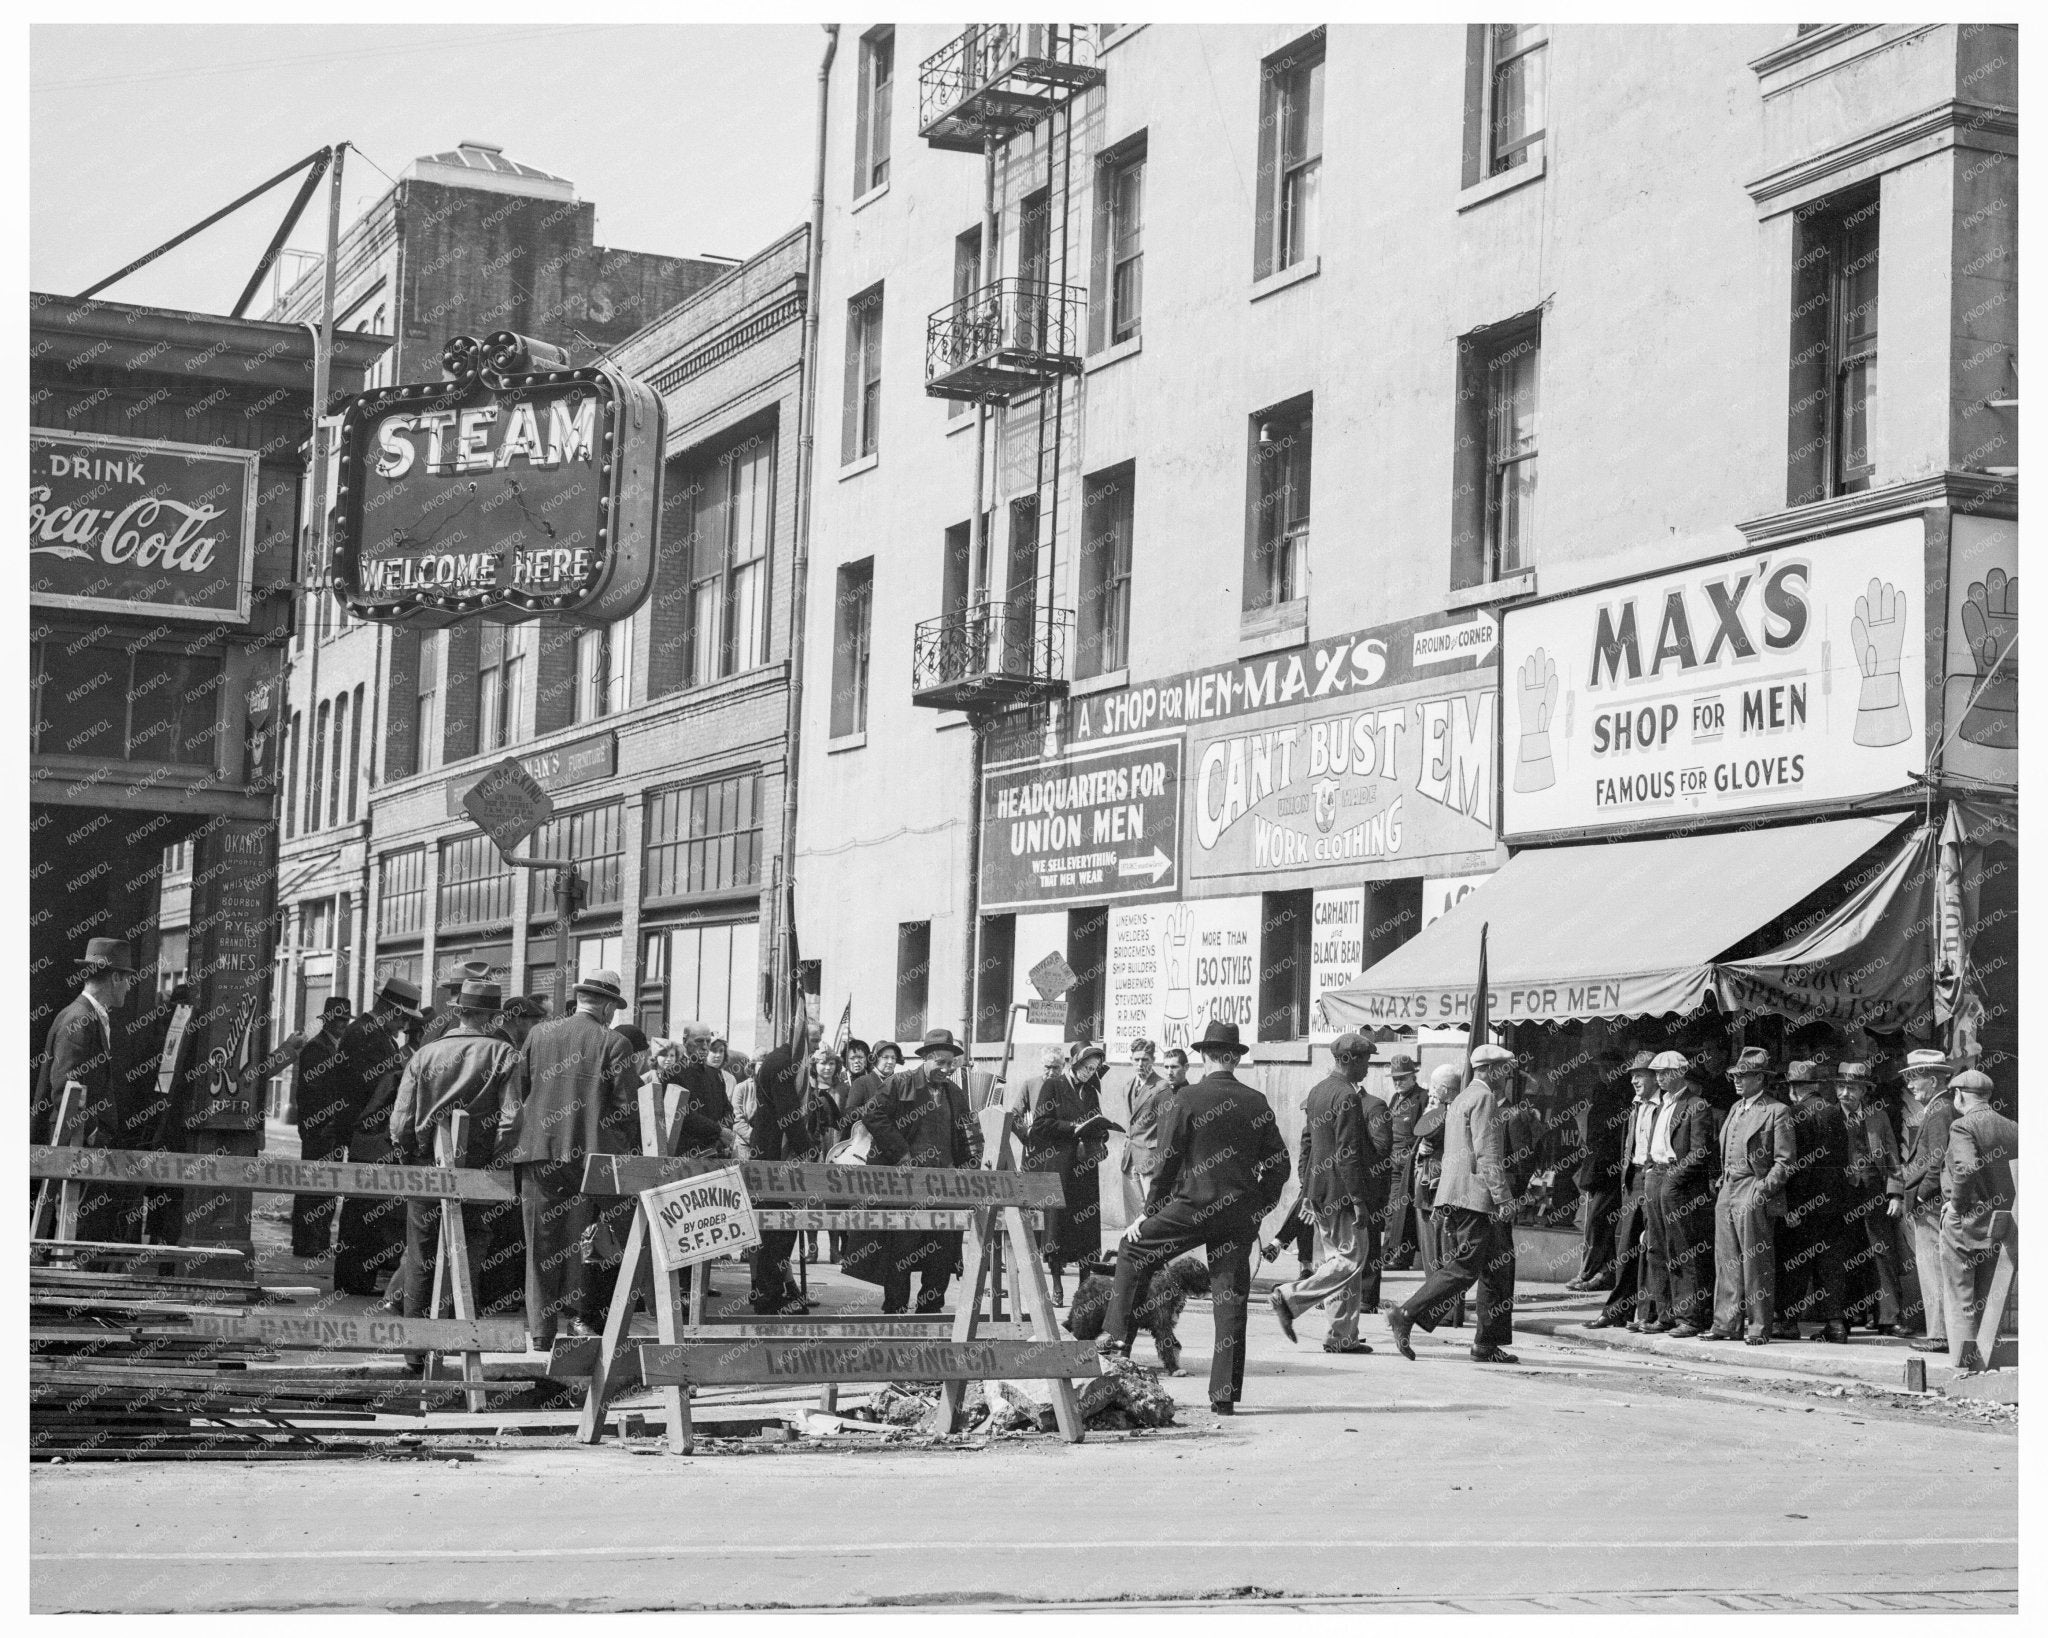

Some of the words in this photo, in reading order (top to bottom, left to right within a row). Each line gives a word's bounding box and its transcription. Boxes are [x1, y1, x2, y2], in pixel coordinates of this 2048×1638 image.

[376, 397, 597, 479] STEAM
[50, 454, 146, 485] DRINK
[359, 553, 500, 592] WELCOME
[512, 546, 594, 584] HERE
[1588, 556, 1810, 690] MAX'S
[1414, 634, 1451, 656] AROUND
[1458, 625, 1493, 647] CORNER
[1078, 702, 1091, 738] A
[1102, 688, 1156, 734] SHOP
[1159, 686, 1182, 721] FOR
[1594, 704, 1679, 754] SHOP
[1693, 703, 1725, 731] FOR
[1742, 682, 1807, 732] MEN
[1196, 727, 1298, 850] CAN'T
[1307, 706, 1406, 781] BUST
[1415, 691, 1497, 830] 'EM
[1596, 771, 1675, 806] FAMOUS
[1680, 771, 1707, 791] FOR
[1714, 754, 1804, 792] GLOVES
[997, 767, 1128, 819] HEADQUARTERS
[1131, 761, 1165, 799] FOR
[1278, 793, 1310, 817] UNION
[1342, 784, 1377, 807] MADE
[1011, 813, 1082, 856] UNION
[1093, 803, 1144, 845] MEN
[1254, 813, 1309, 868] WORK
[1314, 794, 1403, 862] CLOTHING
[1032, 859, 1046, 873] WE
[1048, 855, 1066, 872] SELL
[1066, 851, 1117, 870] EVERYTHING
[1040, 873, 1058, 887] THAT
[1060, 871, 1076, 886] MEN
[1079, 869, 1104, 884] WEAR
[221, 897, 260, 908] BOURBON
[231, 910, 250, 918] AND
[1314, 900, 1360, 925] CARHARTT
[225, 920, 252, 935] RYE
[1116, 914, 1148, 927] LINEMENS
[220, 937, 257, 948] BRANDIES
[1118, 929, 1150, 942] WELDERS
[1202, 932, 1222, 947] MORE
[1227, 931, 1248, 946] THAN
[219, 953, 256, 970] WINES
[1114, 945, 1156, 959] BRIDGEMENS
[1313, 941, 1339, 964] BLACK
[1341, 940, 1361, 964] BEAR
[1113, 962, 1126, 974] SHIP
[1127, 961, 1157, 973] BUILDERS
[1196, 957, 1218, 986] 130
[1221, 956, 1252, 985] STYLES
[1320, 972, 1352, 987] UNION
[1116, 977, 1154, 990] LUMBERMENS
[1031, 1001, 1039, 1010] NO
[1115, 994, 1152, 1006] STEVEDORES
[1209, 996, 1252, 1025] GLOVES
[1370, 993, 1428, 1019] MAX'S
[1510, 989, 1557, 1014] FOR
[1567, 983, 1622, 1011] MEN
[1116, 1026, 1147, 1038] RIGGERS
[243, 1161, 342, 1189] STREET
[354, 1167, 457, 1195] CLOSED
[826, 1169, 914, 1197] STREET
[925, 1172, 1017, 1199] CLOSED
[660, 1201, 684, 1229] NO
[679, 1186, 742, 1214] PARKING
[684, 1221, 695, 1234] BY
[697, 1213, 727, 1230] ORDER
[678, 1222, 746, 1254] S.F.P.D.
[260, 1319, 358, 1343] PAVING
[868, 1347, 957, 1373] PAVING
